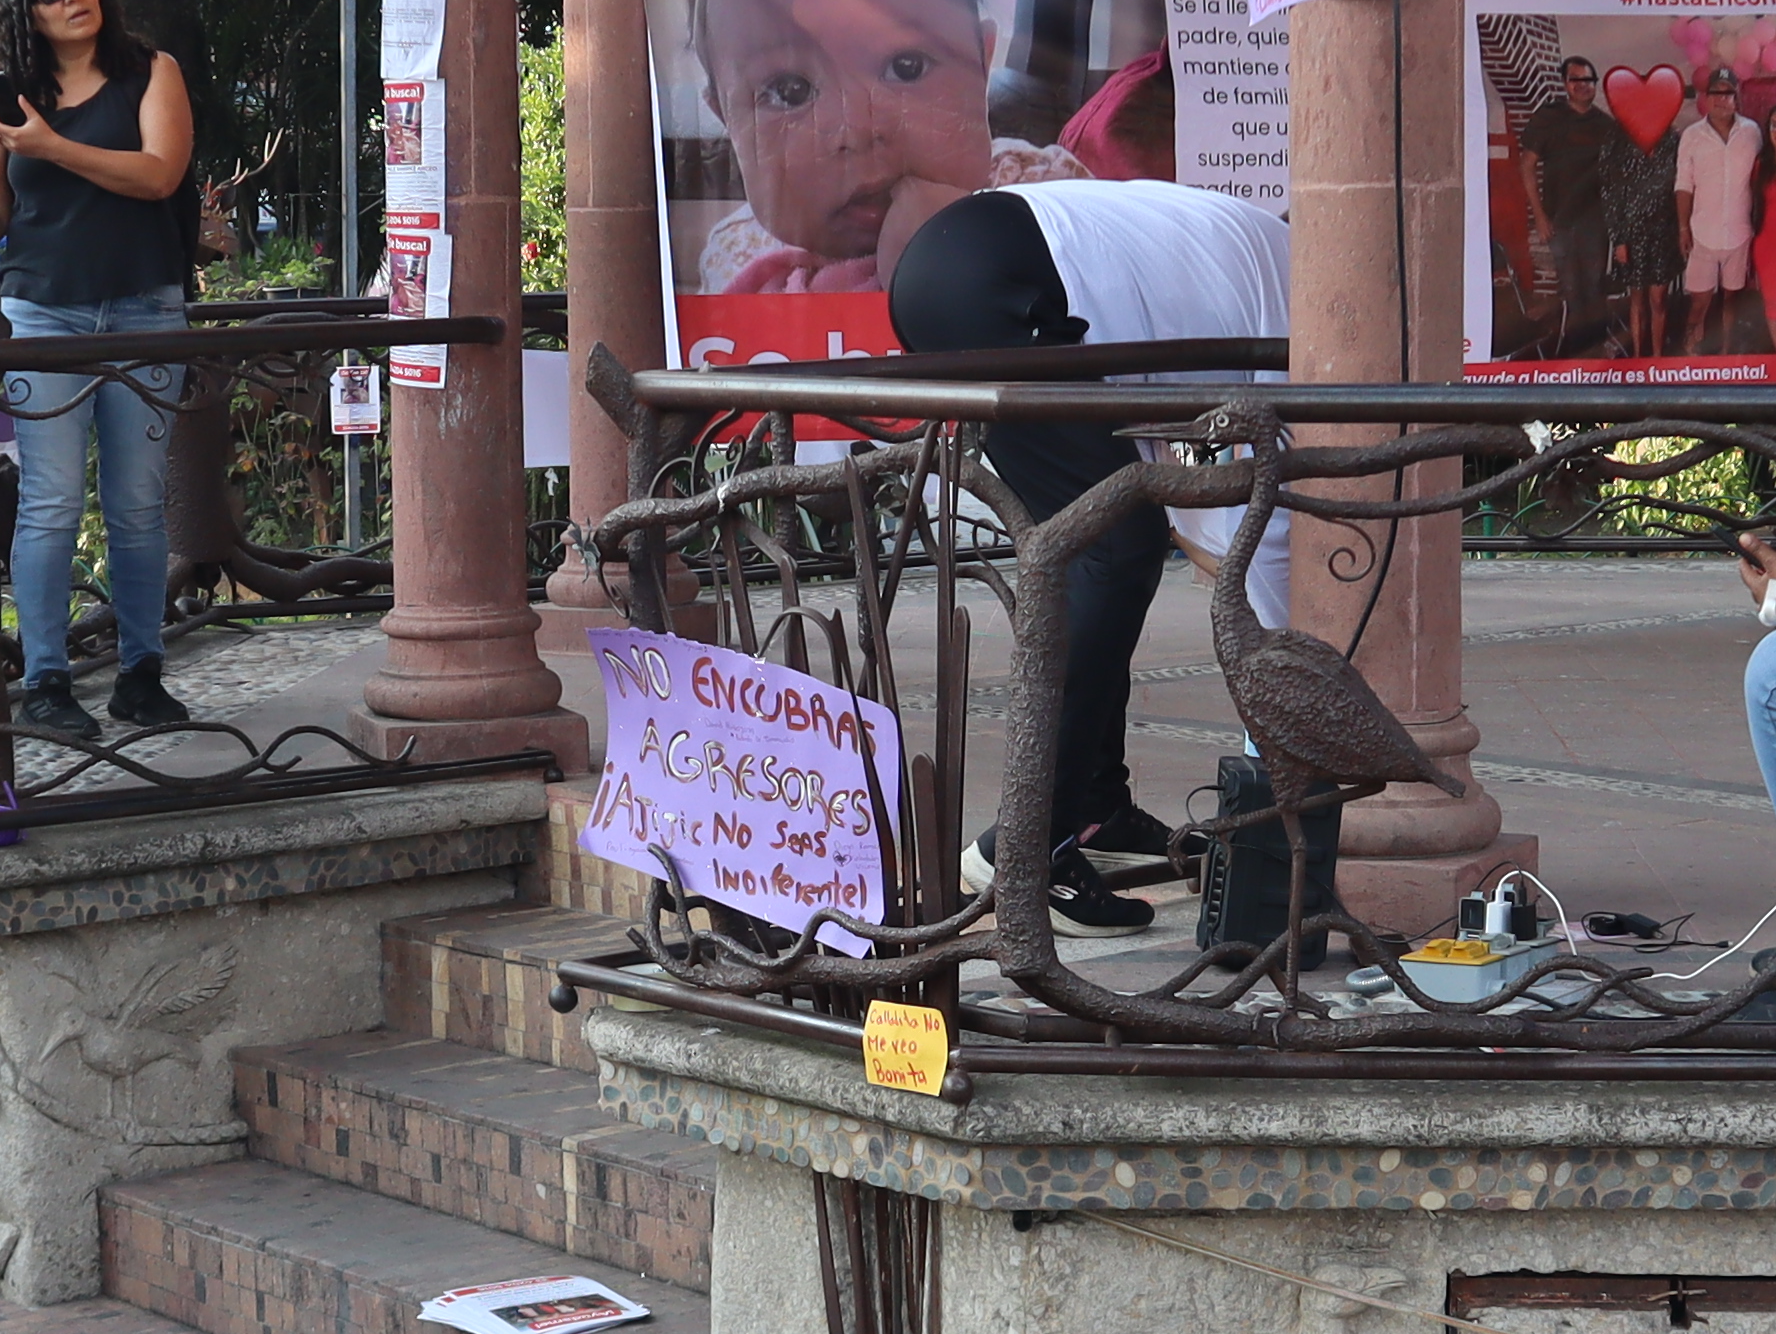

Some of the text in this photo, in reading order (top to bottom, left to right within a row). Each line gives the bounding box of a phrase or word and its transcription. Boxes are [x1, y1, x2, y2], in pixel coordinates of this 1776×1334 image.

[1177, 27, 1290, 53] padre, quie
[1183, 57, 1279, 76] mantiene
[390, 85, 420, 99] busca!
[1203, 86, 1289, 105] de famili
[1232, 122, 1270, 145] que
[1198, 149, 1289, 175] suspendi
[1259, 183, 1284, 199] no
[395, 239, 427, 252] busca!
[1533, 368, 1622, 384] localizarla
[1625, 371, 1645, 383] es
[1648, 364, 1769, 383] fundamental.
[602, 645, 876, 757] NO ENCUBRAS
[639, 717, 871, 836] AGRESORES
[869, 1008, 919, 1029] Calladita
[891, 1037, 918, 1055] veo
[872, 1057, 928, 1088] Bonita
